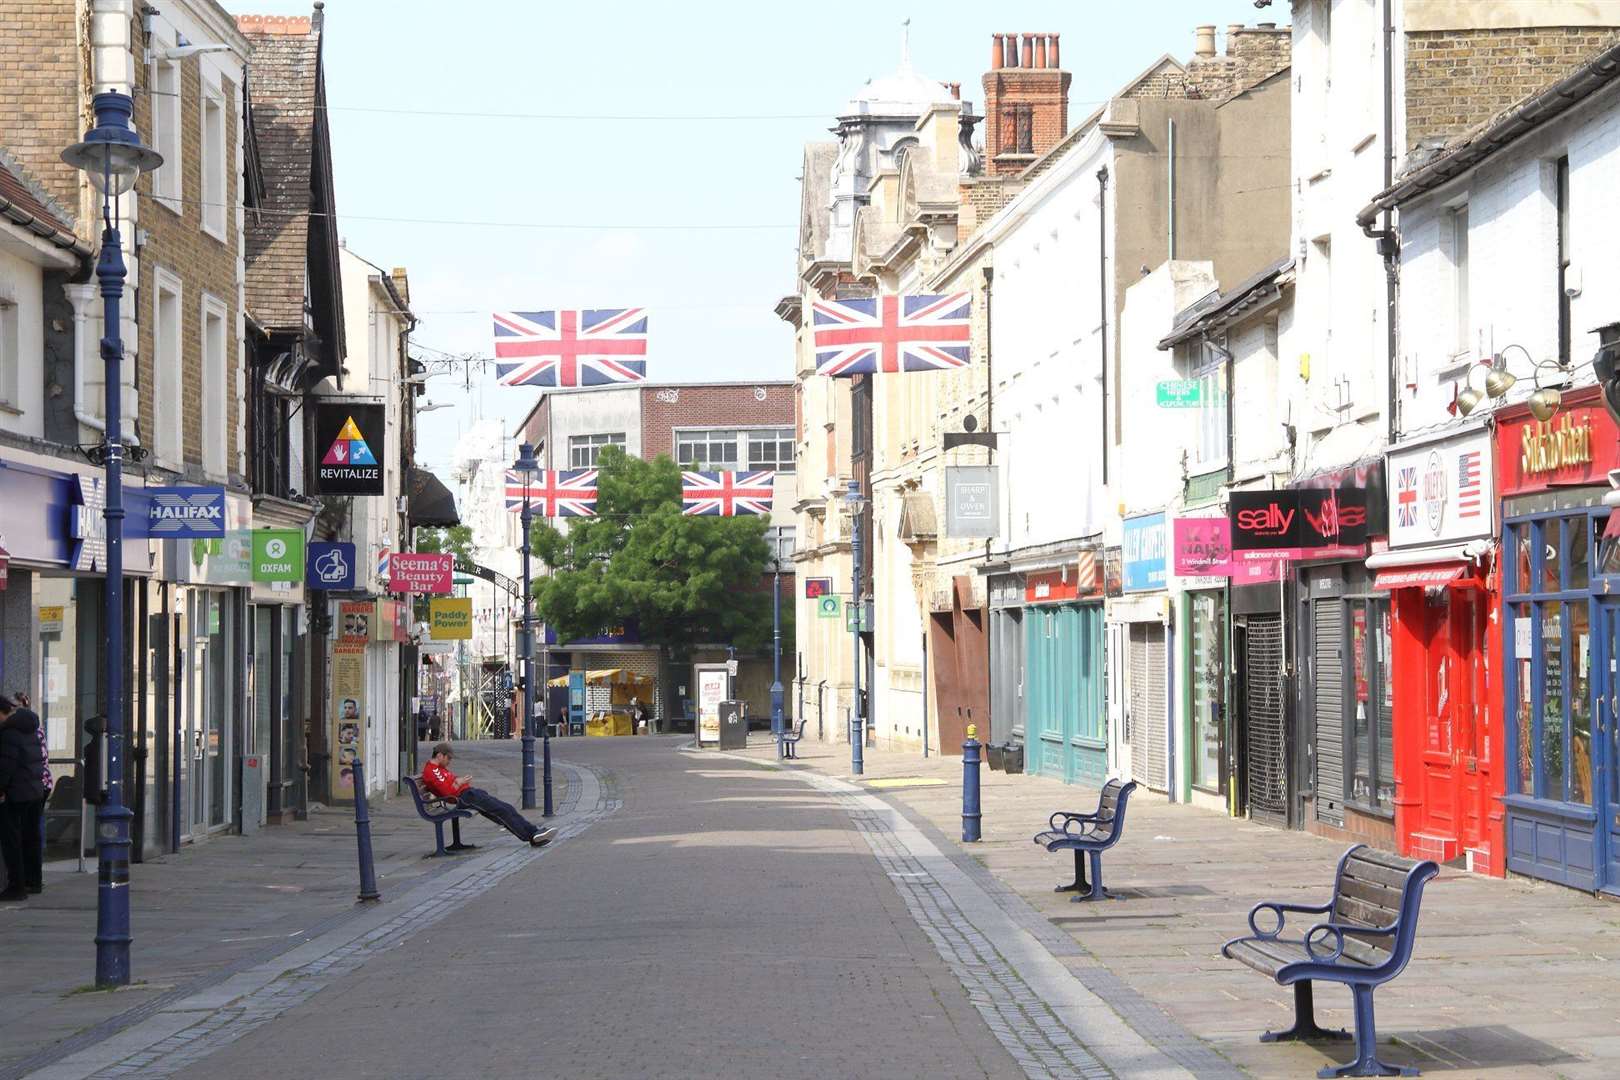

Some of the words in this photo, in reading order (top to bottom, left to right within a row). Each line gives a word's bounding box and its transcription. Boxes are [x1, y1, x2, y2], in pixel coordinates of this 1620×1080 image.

[320, 468, 379, 479] REVITALIZE
[150, 505, 222, 519] HALIFAX
[1238, 503, 1296, 535] sally
[260, 563, 292, 573] OXFAM
[392, 556, 450, 571] Seema's
[396, 571, 445, 583] Beauty
[410, 581, 433, 591] Bar
[434, 611, 468, 620] Paddy
[434, 620, 469, 628] Power
